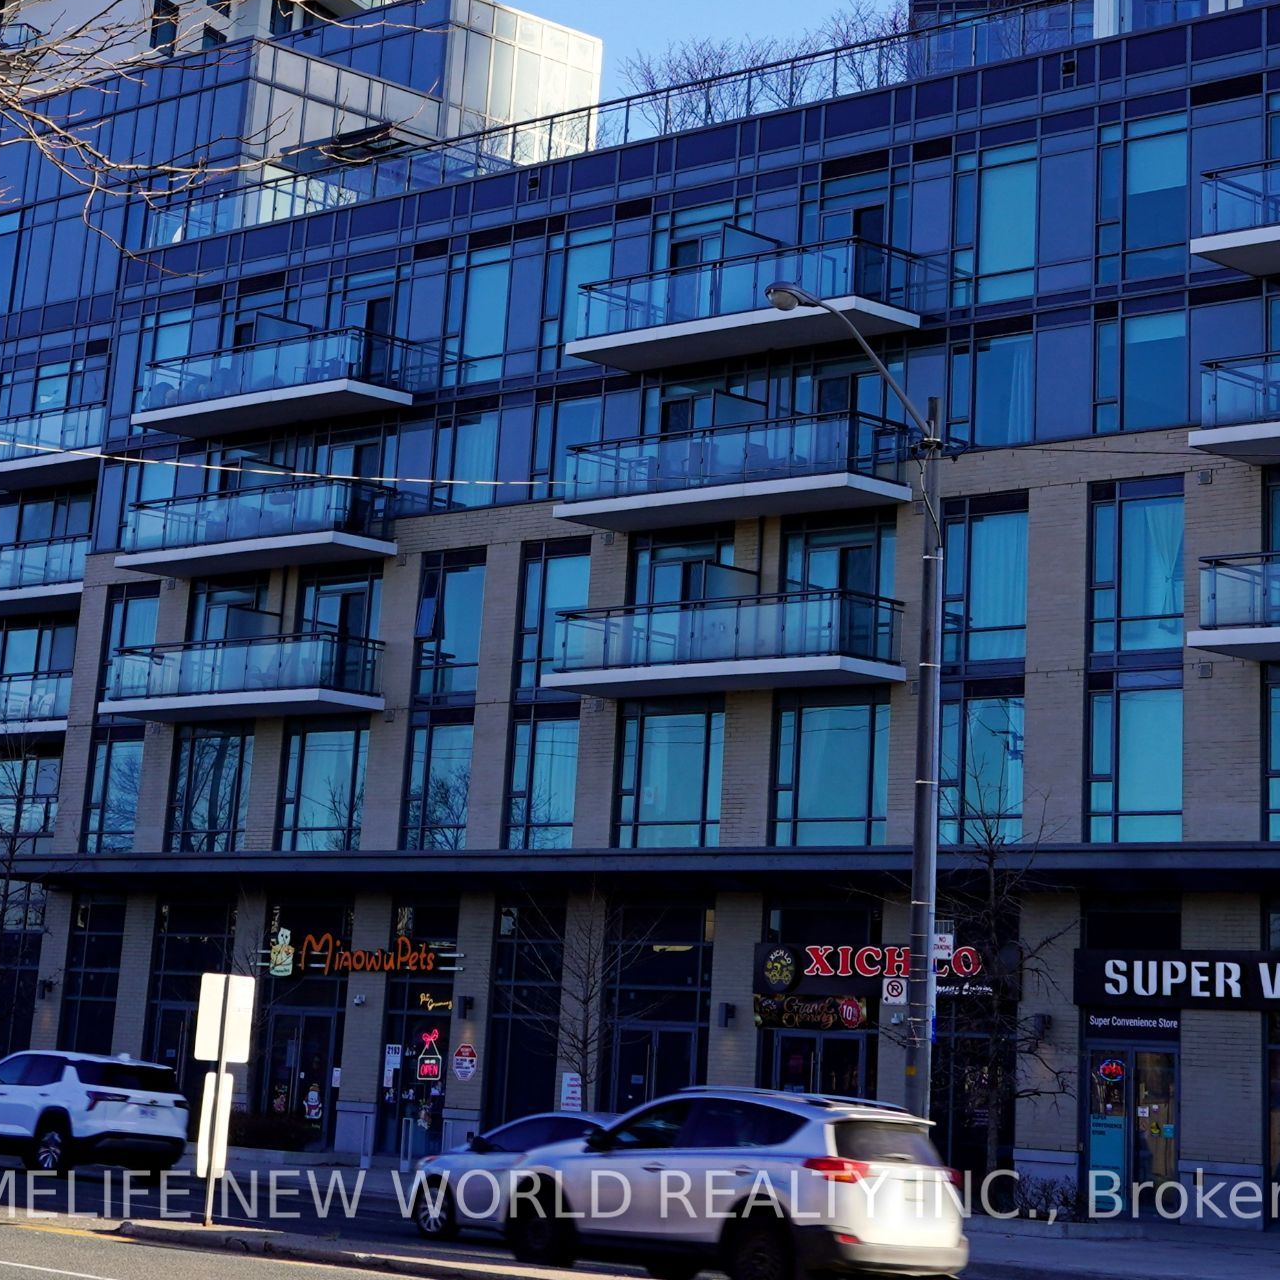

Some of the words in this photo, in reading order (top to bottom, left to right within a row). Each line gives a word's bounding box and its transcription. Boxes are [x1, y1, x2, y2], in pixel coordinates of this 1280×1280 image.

[804, 945, 911, 977] XICH
[1104, 959, 1242, 998] SUPER
[1089, 1015, 1110, 1028] Super
[1111, 1016, 1157, 1027] Convenience
[1158, 1018, 1179, 1029] Store
[420, 1063, 439, 1076] OPEN
